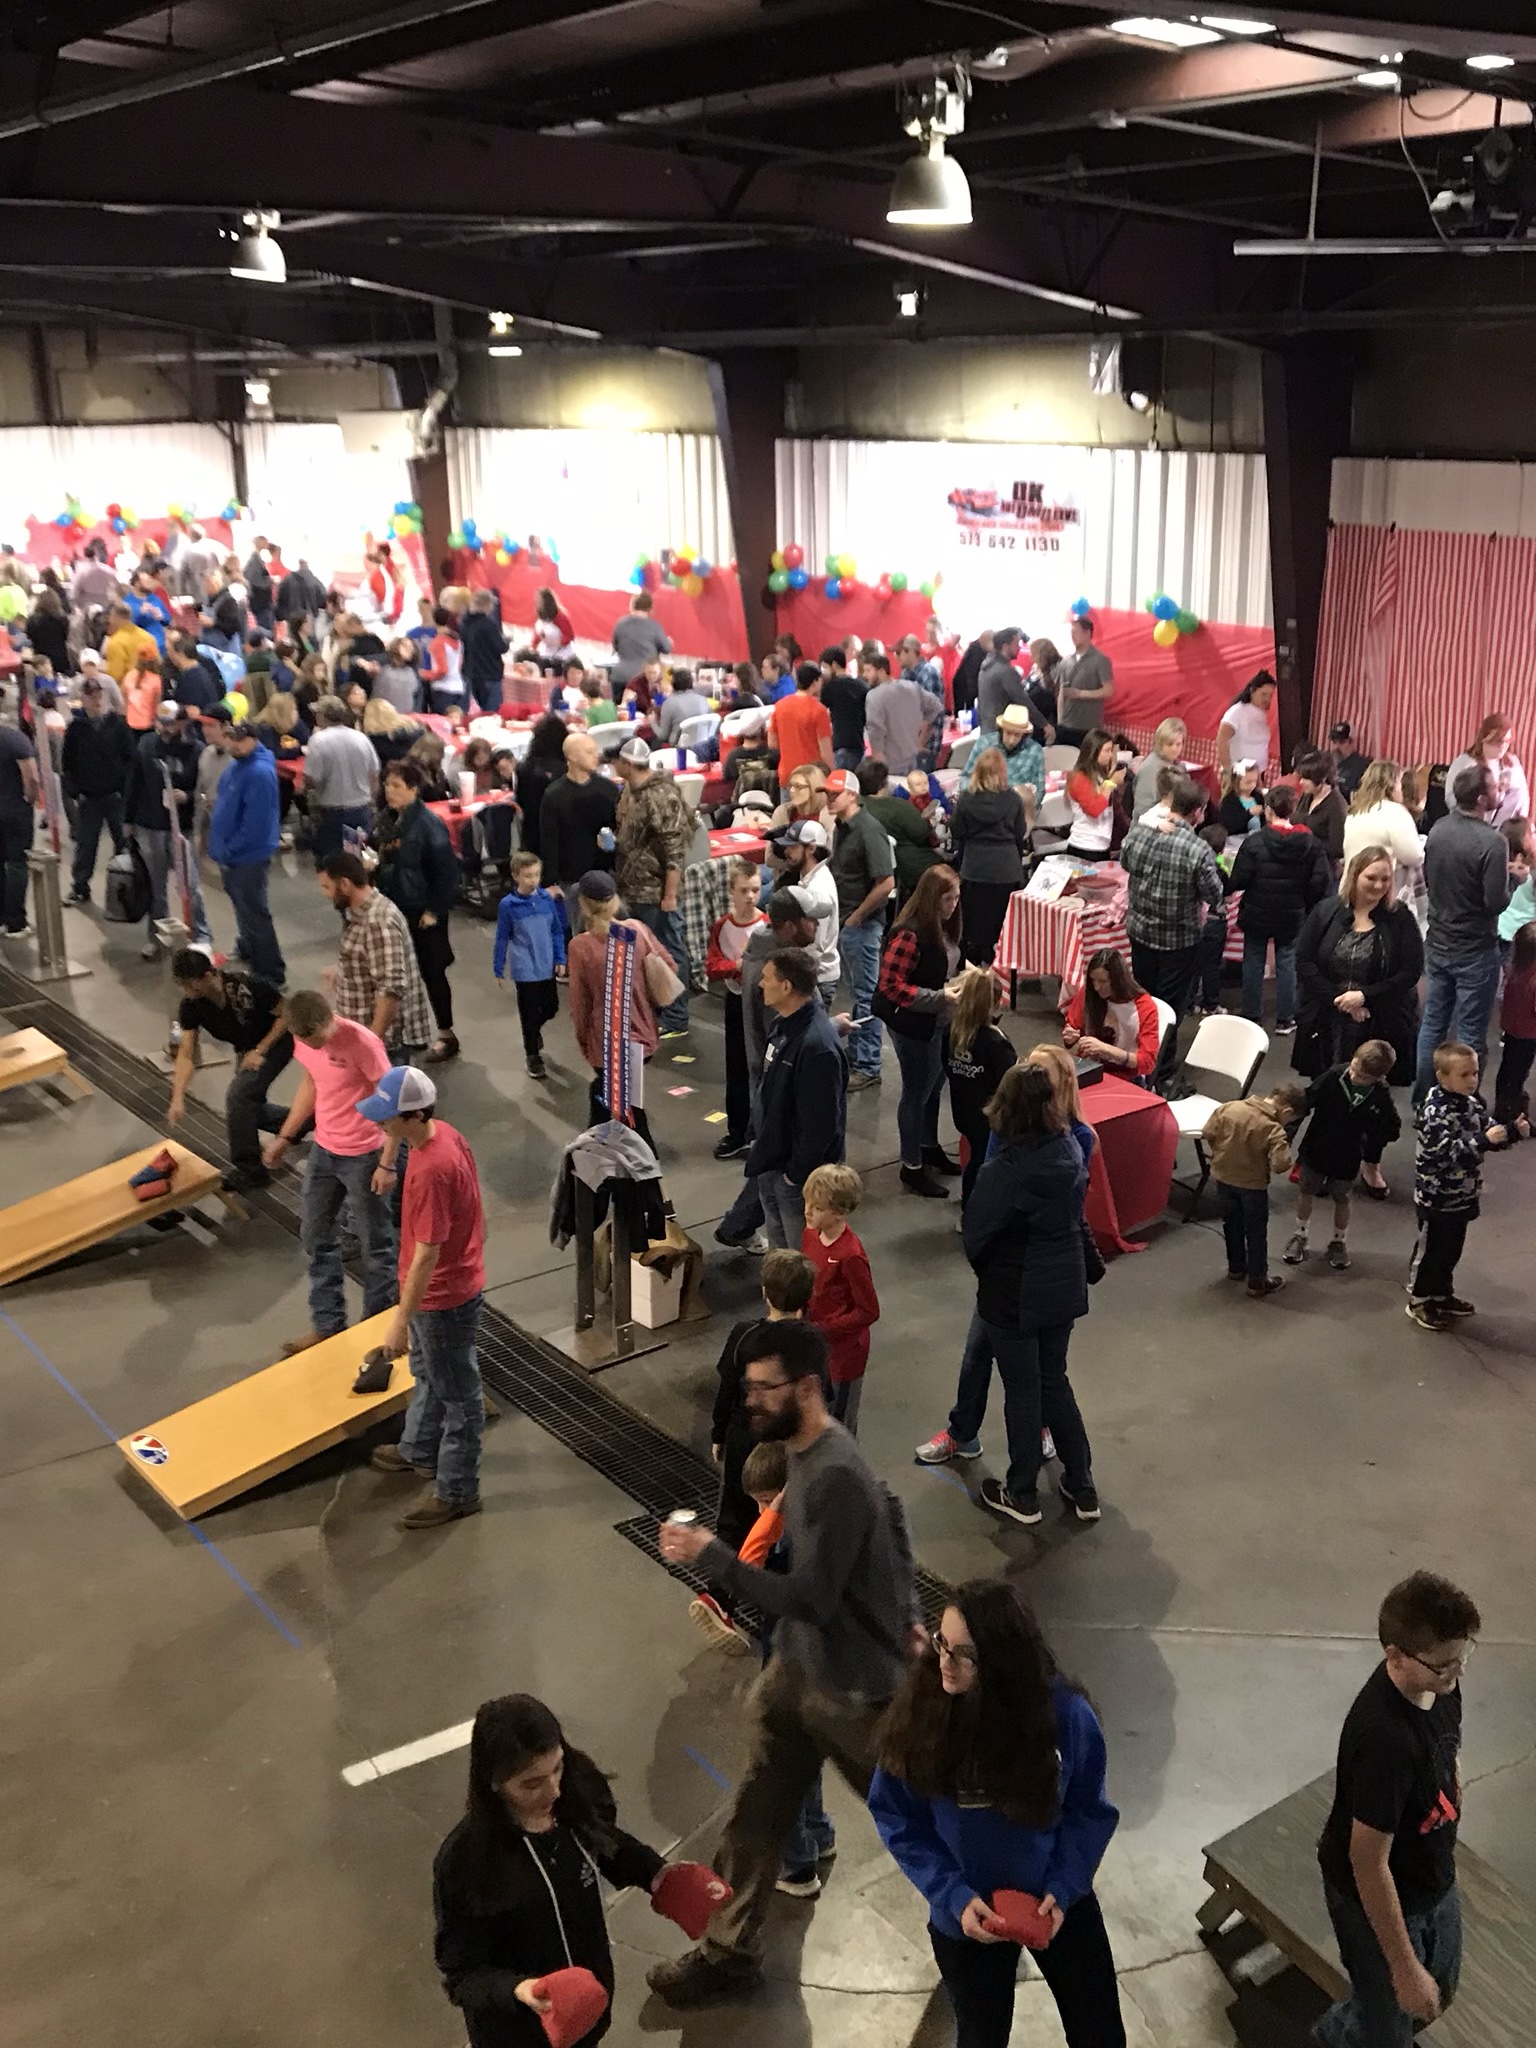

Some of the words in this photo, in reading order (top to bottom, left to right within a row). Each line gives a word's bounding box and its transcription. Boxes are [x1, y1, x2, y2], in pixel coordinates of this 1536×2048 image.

[988, 535, 1015, 550] 642
[1025, 536, 1060, 552] 1130
[613, 945, 624, 1018] CAPITAL
